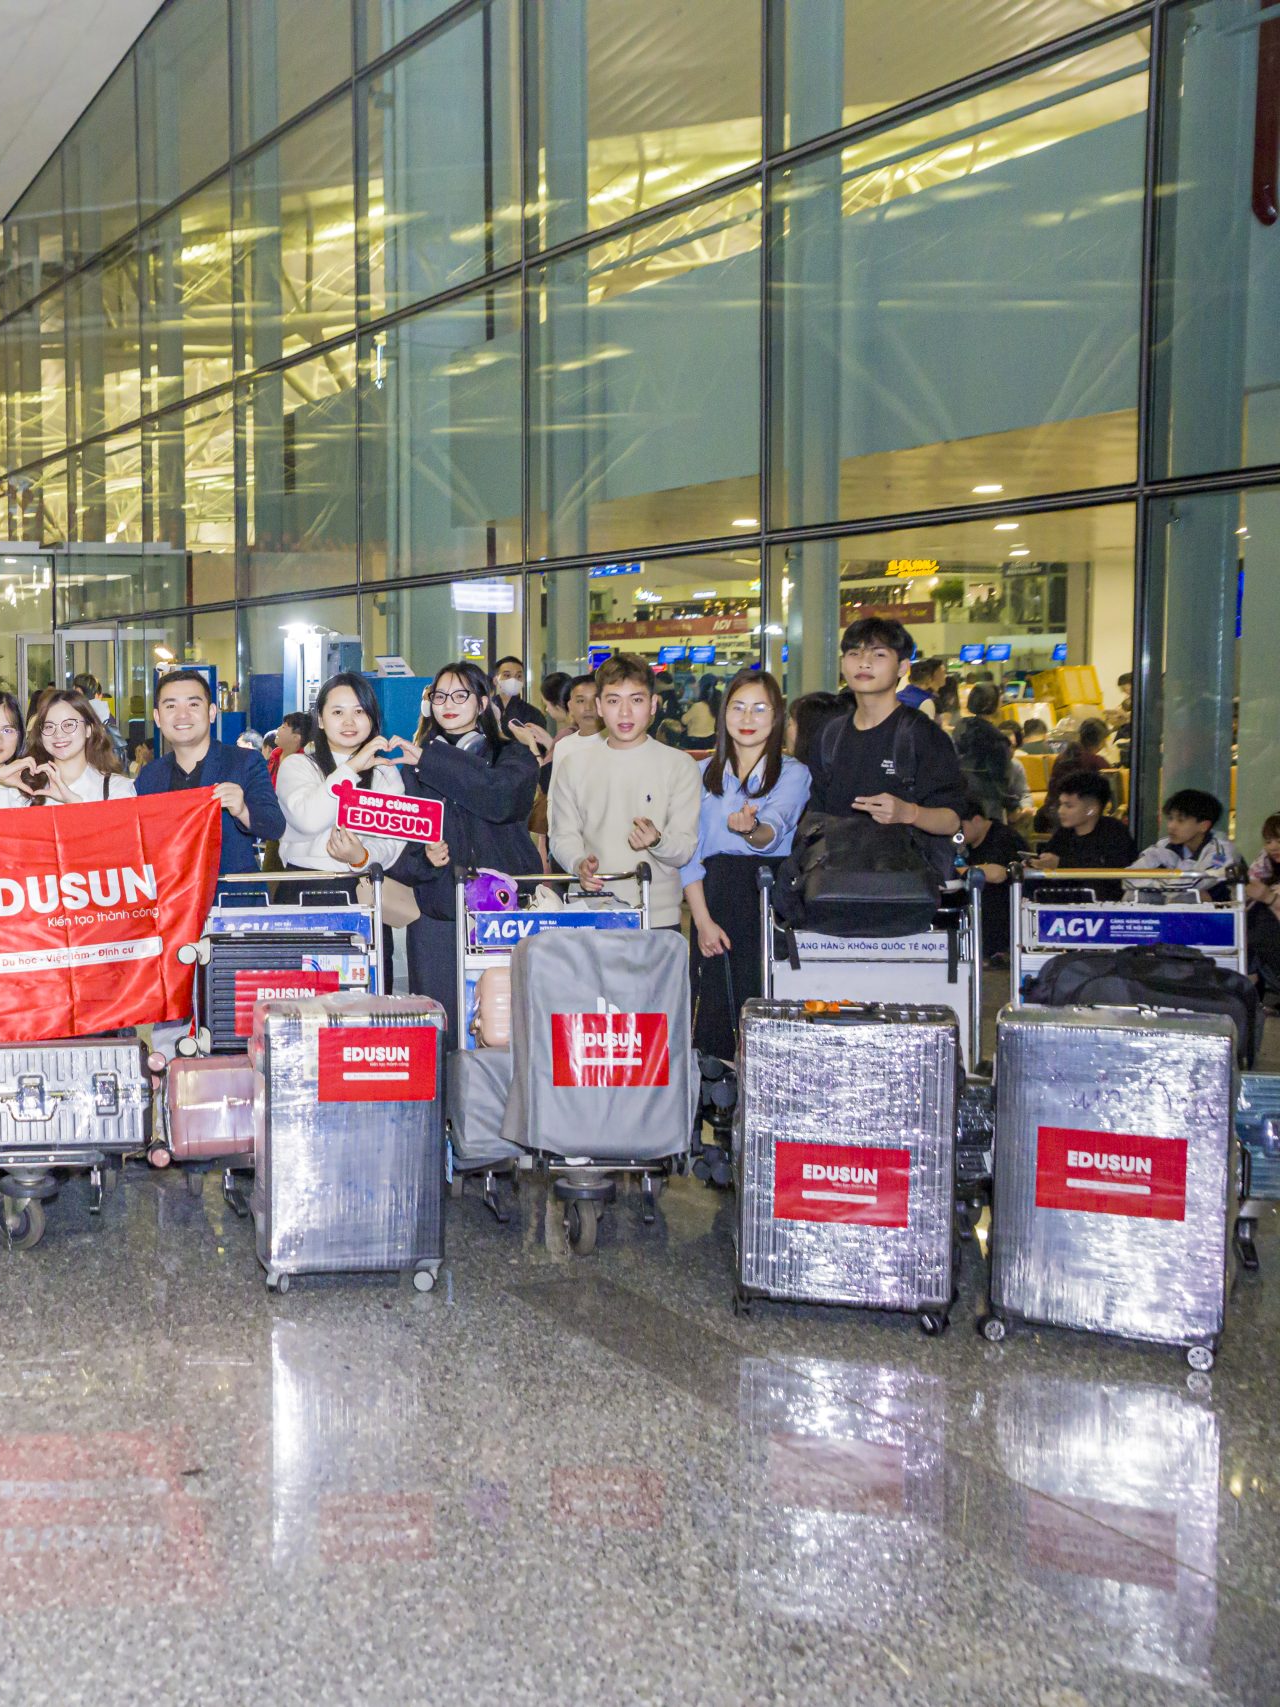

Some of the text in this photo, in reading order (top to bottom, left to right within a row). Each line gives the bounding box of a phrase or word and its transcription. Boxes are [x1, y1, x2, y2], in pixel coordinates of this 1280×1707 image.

[359, 796, 383, 808] BAY
[347, 807, 432, 837] EDUSUN
[47, 907, 160, 927] Kiến tạo thành công
[1047, 917, 1105, 937] ACV
[484, 920, 535, 938] ACV
[2, 958, 16, 967] Du
[122, 946, 135, 954] cư
[820, 941, 845, 950] HÀNG
[847, 941, 879, 950] KHÔNG
[921, 943, 937, 952] NỘI
[342, 1046, 410, 1062] EDUSUN
[1066, 1150, 1152, 1175] EDUSUN
[802, 1163, 878, 1184] EDUSUN
